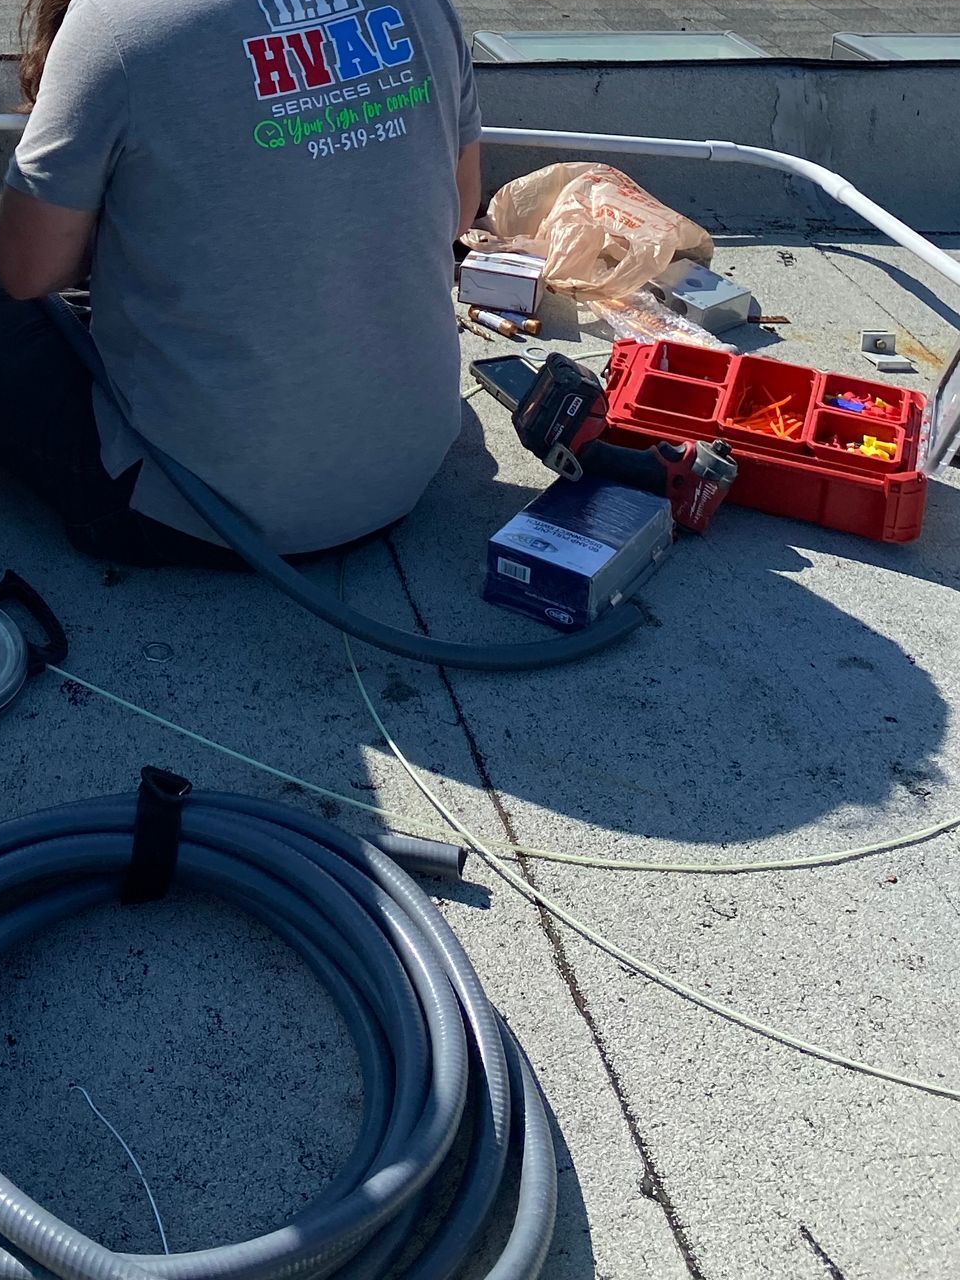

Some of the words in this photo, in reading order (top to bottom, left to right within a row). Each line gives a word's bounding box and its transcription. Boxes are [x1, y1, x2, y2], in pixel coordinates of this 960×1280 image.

[243, 5, 414, 100] HVAC
[271, 82, 371, 117] SERVICES
[378, 70, 414, 90] LLC
[362, 101, 383, 124] for
[308, 117, 407, 160] 951-519-3211
